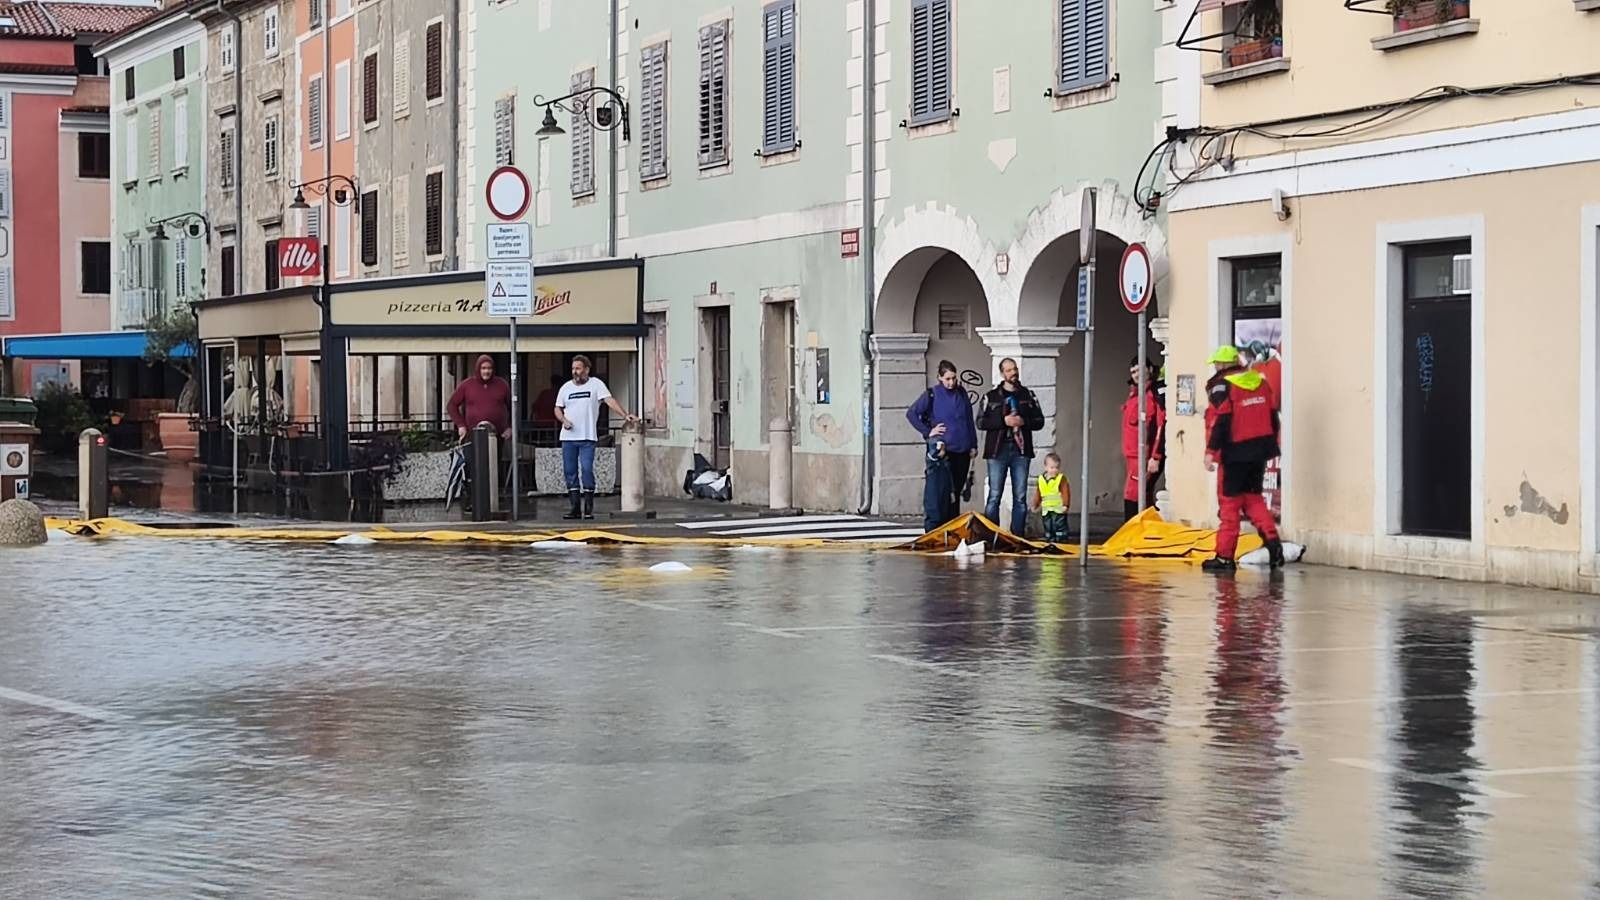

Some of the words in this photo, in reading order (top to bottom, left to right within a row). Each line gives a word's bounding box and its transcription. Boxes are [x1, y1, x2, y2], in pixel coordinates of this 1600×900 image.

[282, 242, 317, 273] illy
[388, 300, 452, 315] pizzeria
[455, 298, 487, 313] NA
